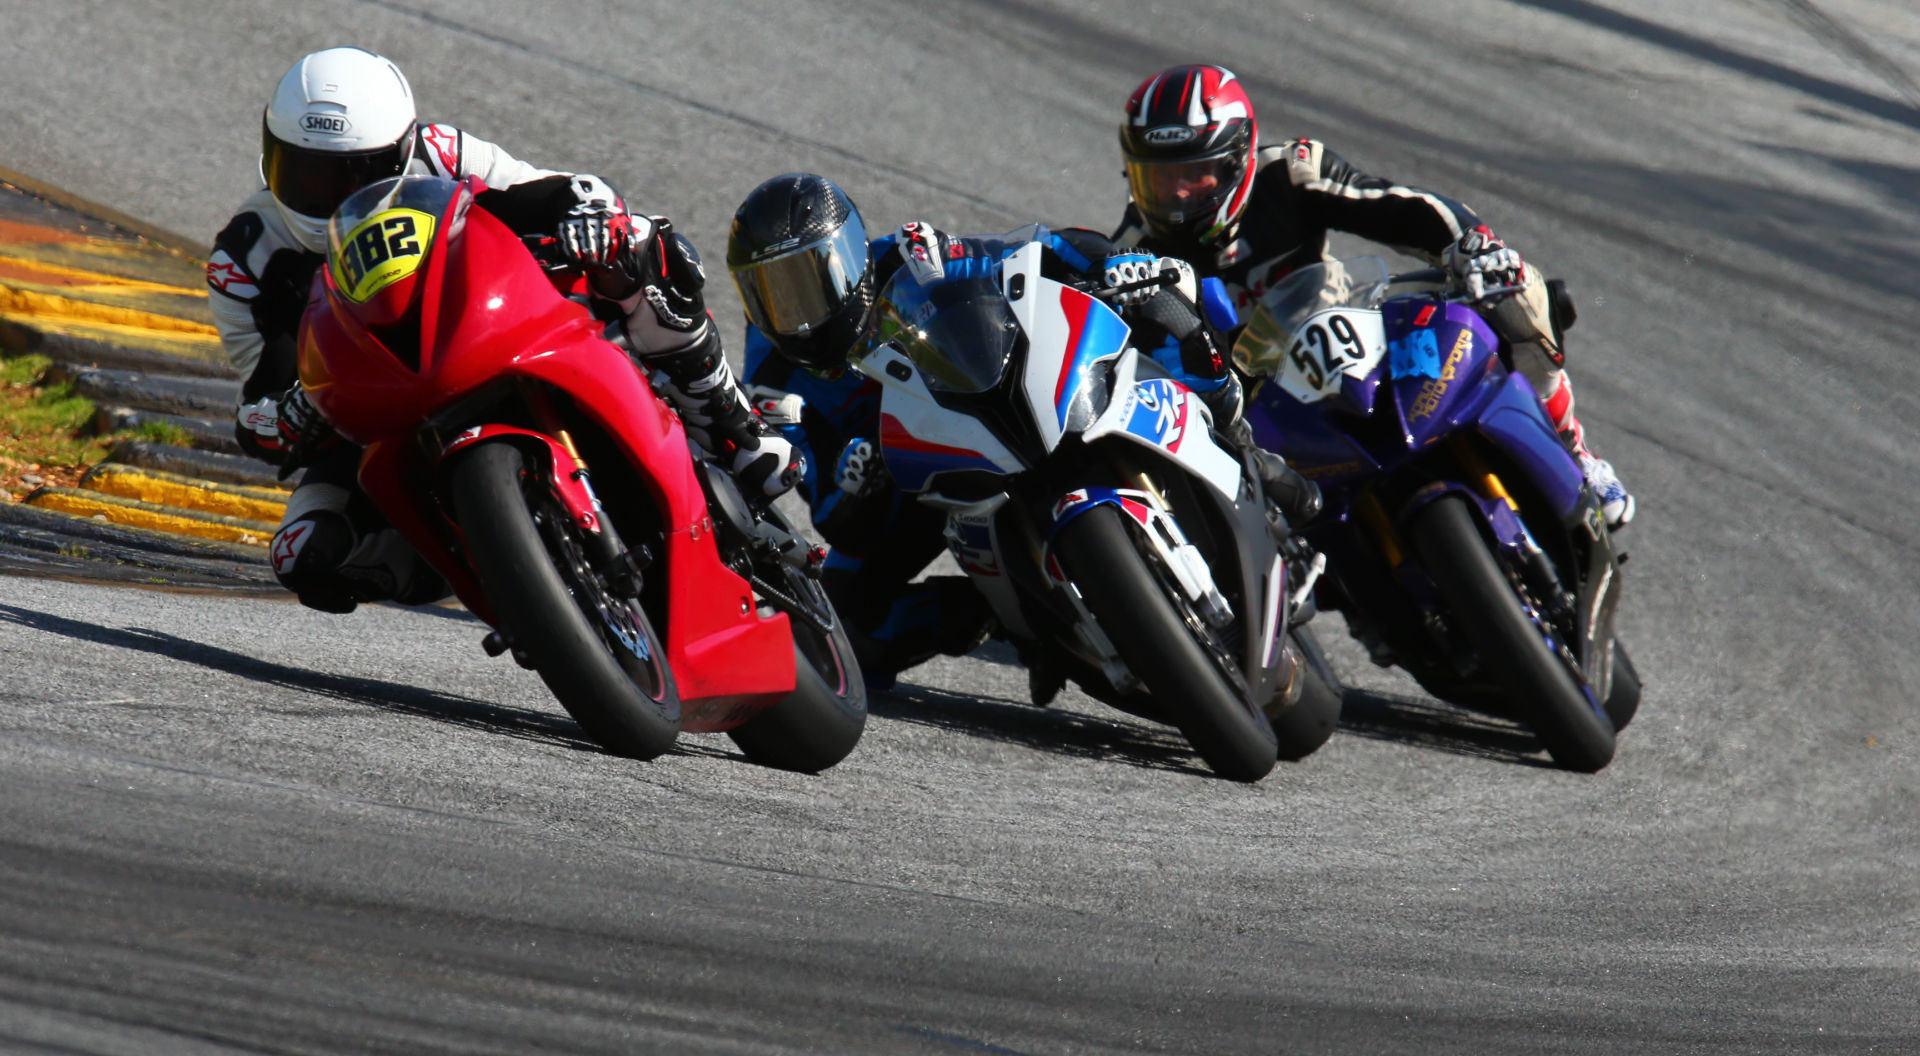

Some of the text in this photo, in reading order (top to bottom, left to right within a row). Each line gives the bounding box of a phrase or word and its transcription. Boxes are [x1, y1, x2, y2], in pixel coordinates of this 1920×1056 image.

[305, 116, 344, 132] SHOEI
[1148, 128, 1187, 142] HJC
[752, 237, 801, 260] LS2
[1290, 314, 1366, 391] 529
